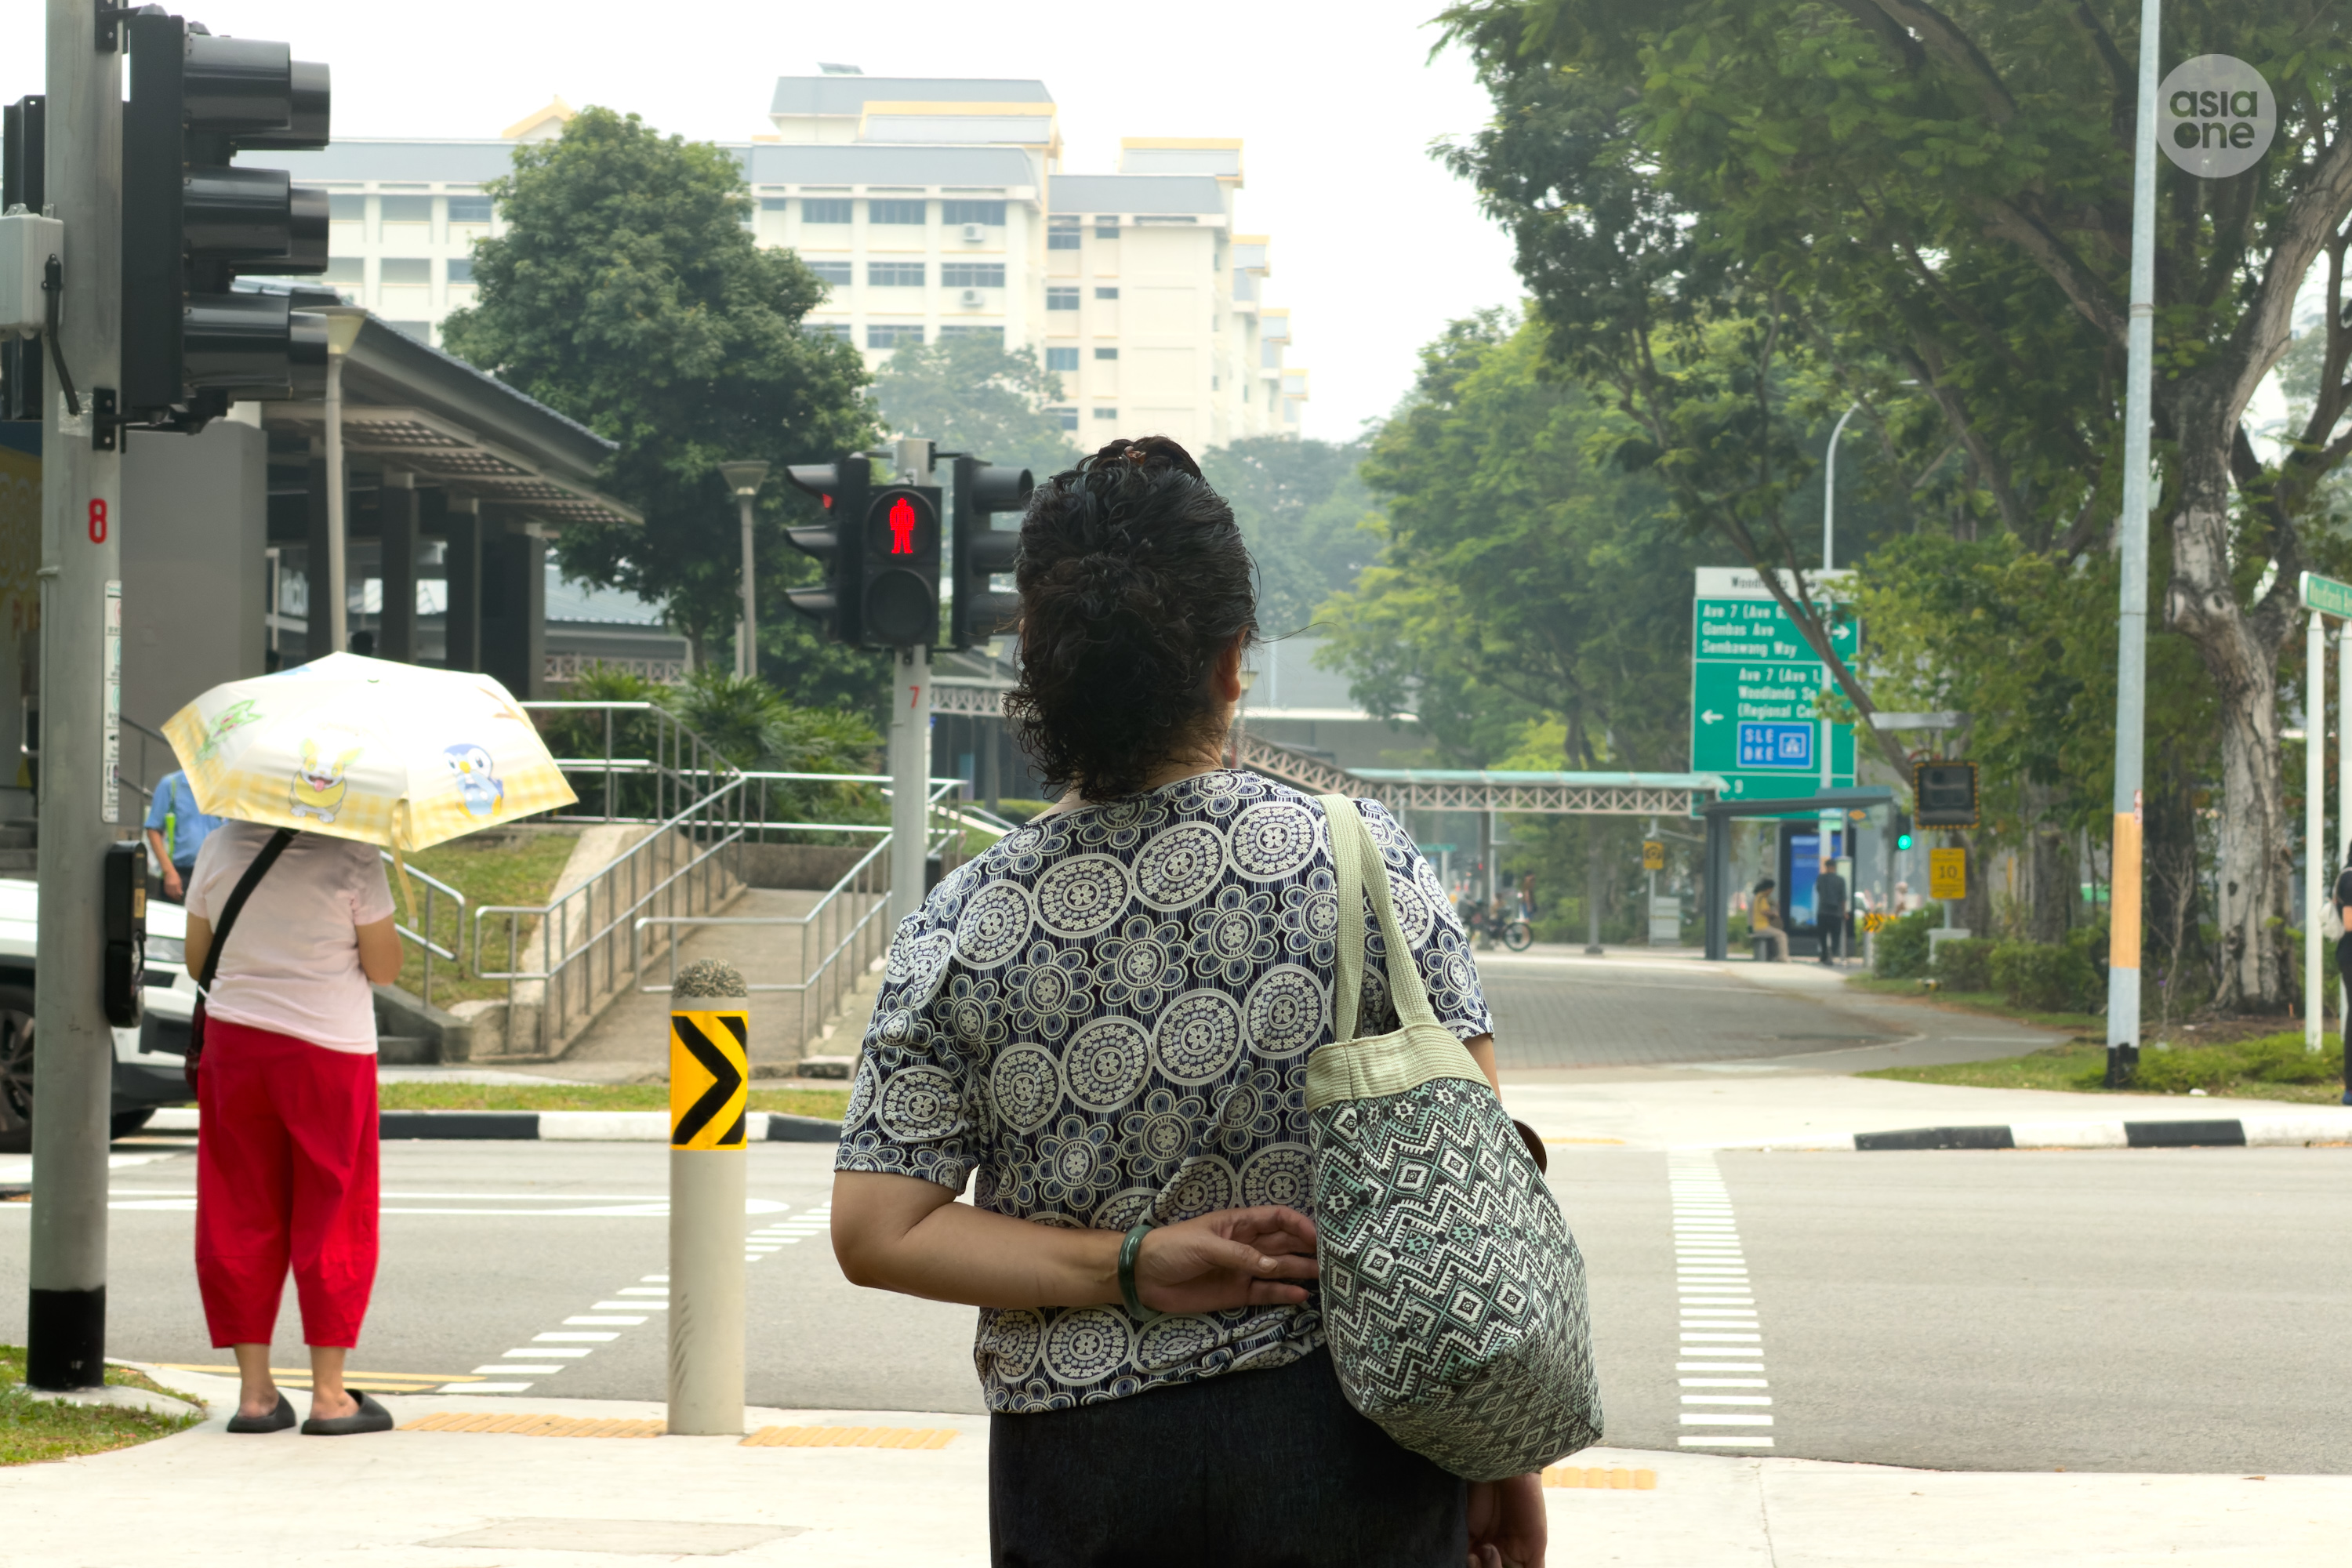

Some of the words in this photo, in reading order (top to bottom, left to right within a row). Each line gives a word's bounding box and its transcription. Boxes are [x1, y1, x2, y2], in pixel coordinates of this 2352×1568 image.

[89, 498, 107, 544] 8
[1702, 604, 1725, 618] Ave
[1730, 604, 1738, 619] 7
[1742, 604, 1771, 619] (Ave
[1752, 622, 1775, 637] Ave
[1773, 641, 1798, 659] Way
[1738, 667, 1761, 681] Ave
[1766, 667, 1774, 681] 7
[1778, 667, 1807, 683] (Ave
[909, 685, 920, 709] 7
[1737, 684, 1797, 700] Woodlands
[1744, 728, 1773, 743] SLE
[1939, 865, 1958, 879] 10
